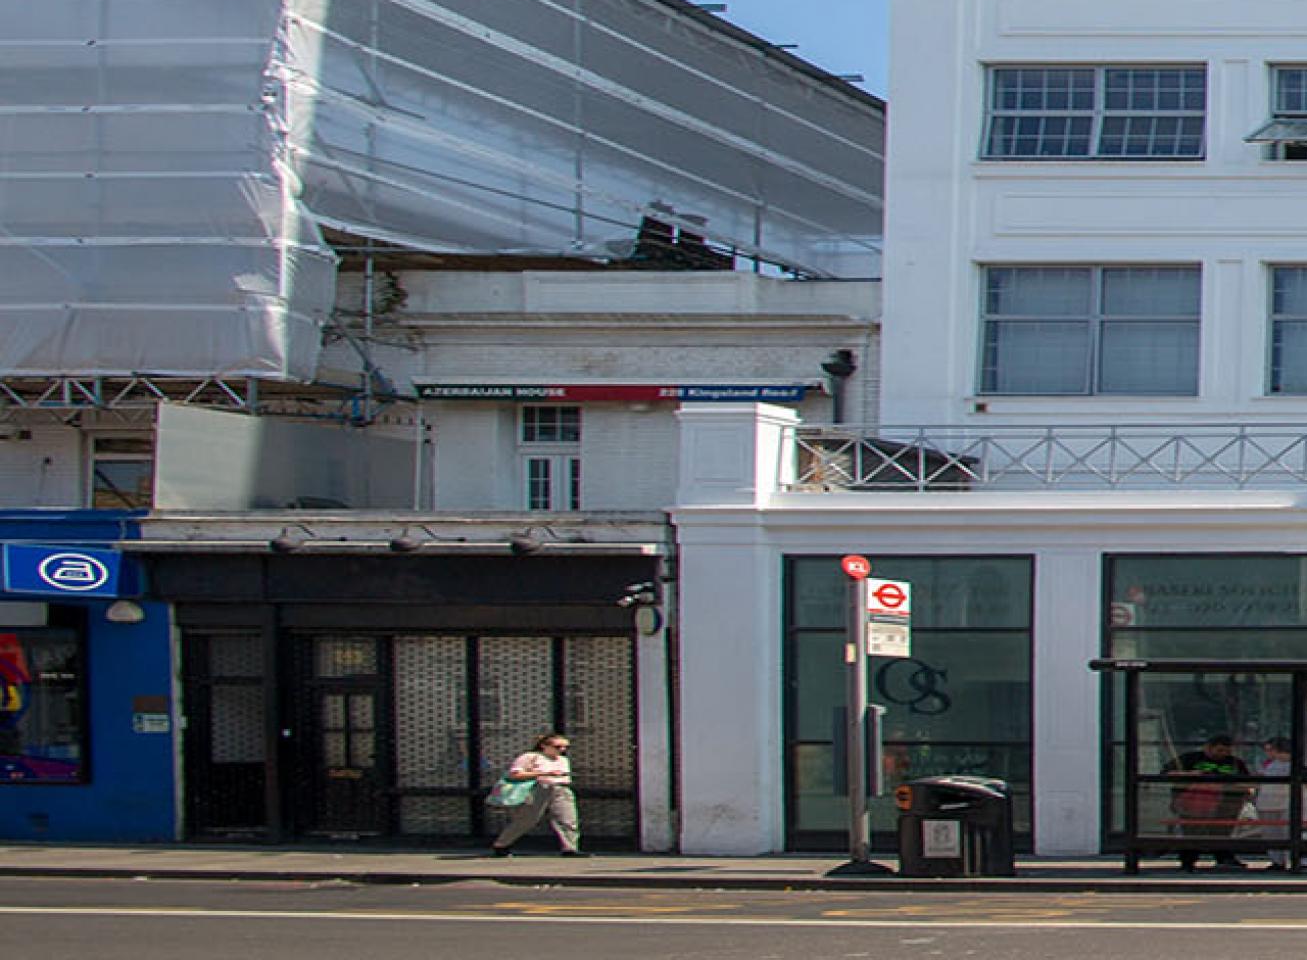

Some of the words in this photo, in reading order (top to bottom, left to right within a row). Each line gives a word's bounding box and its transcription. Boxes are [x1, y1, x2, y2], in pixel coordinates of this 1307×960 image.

[423, 387, 513, 397] AZERBAIJAN
[516, 387, 567, 397] HOUSE
[687, 387, 758, 399] Kingsland
